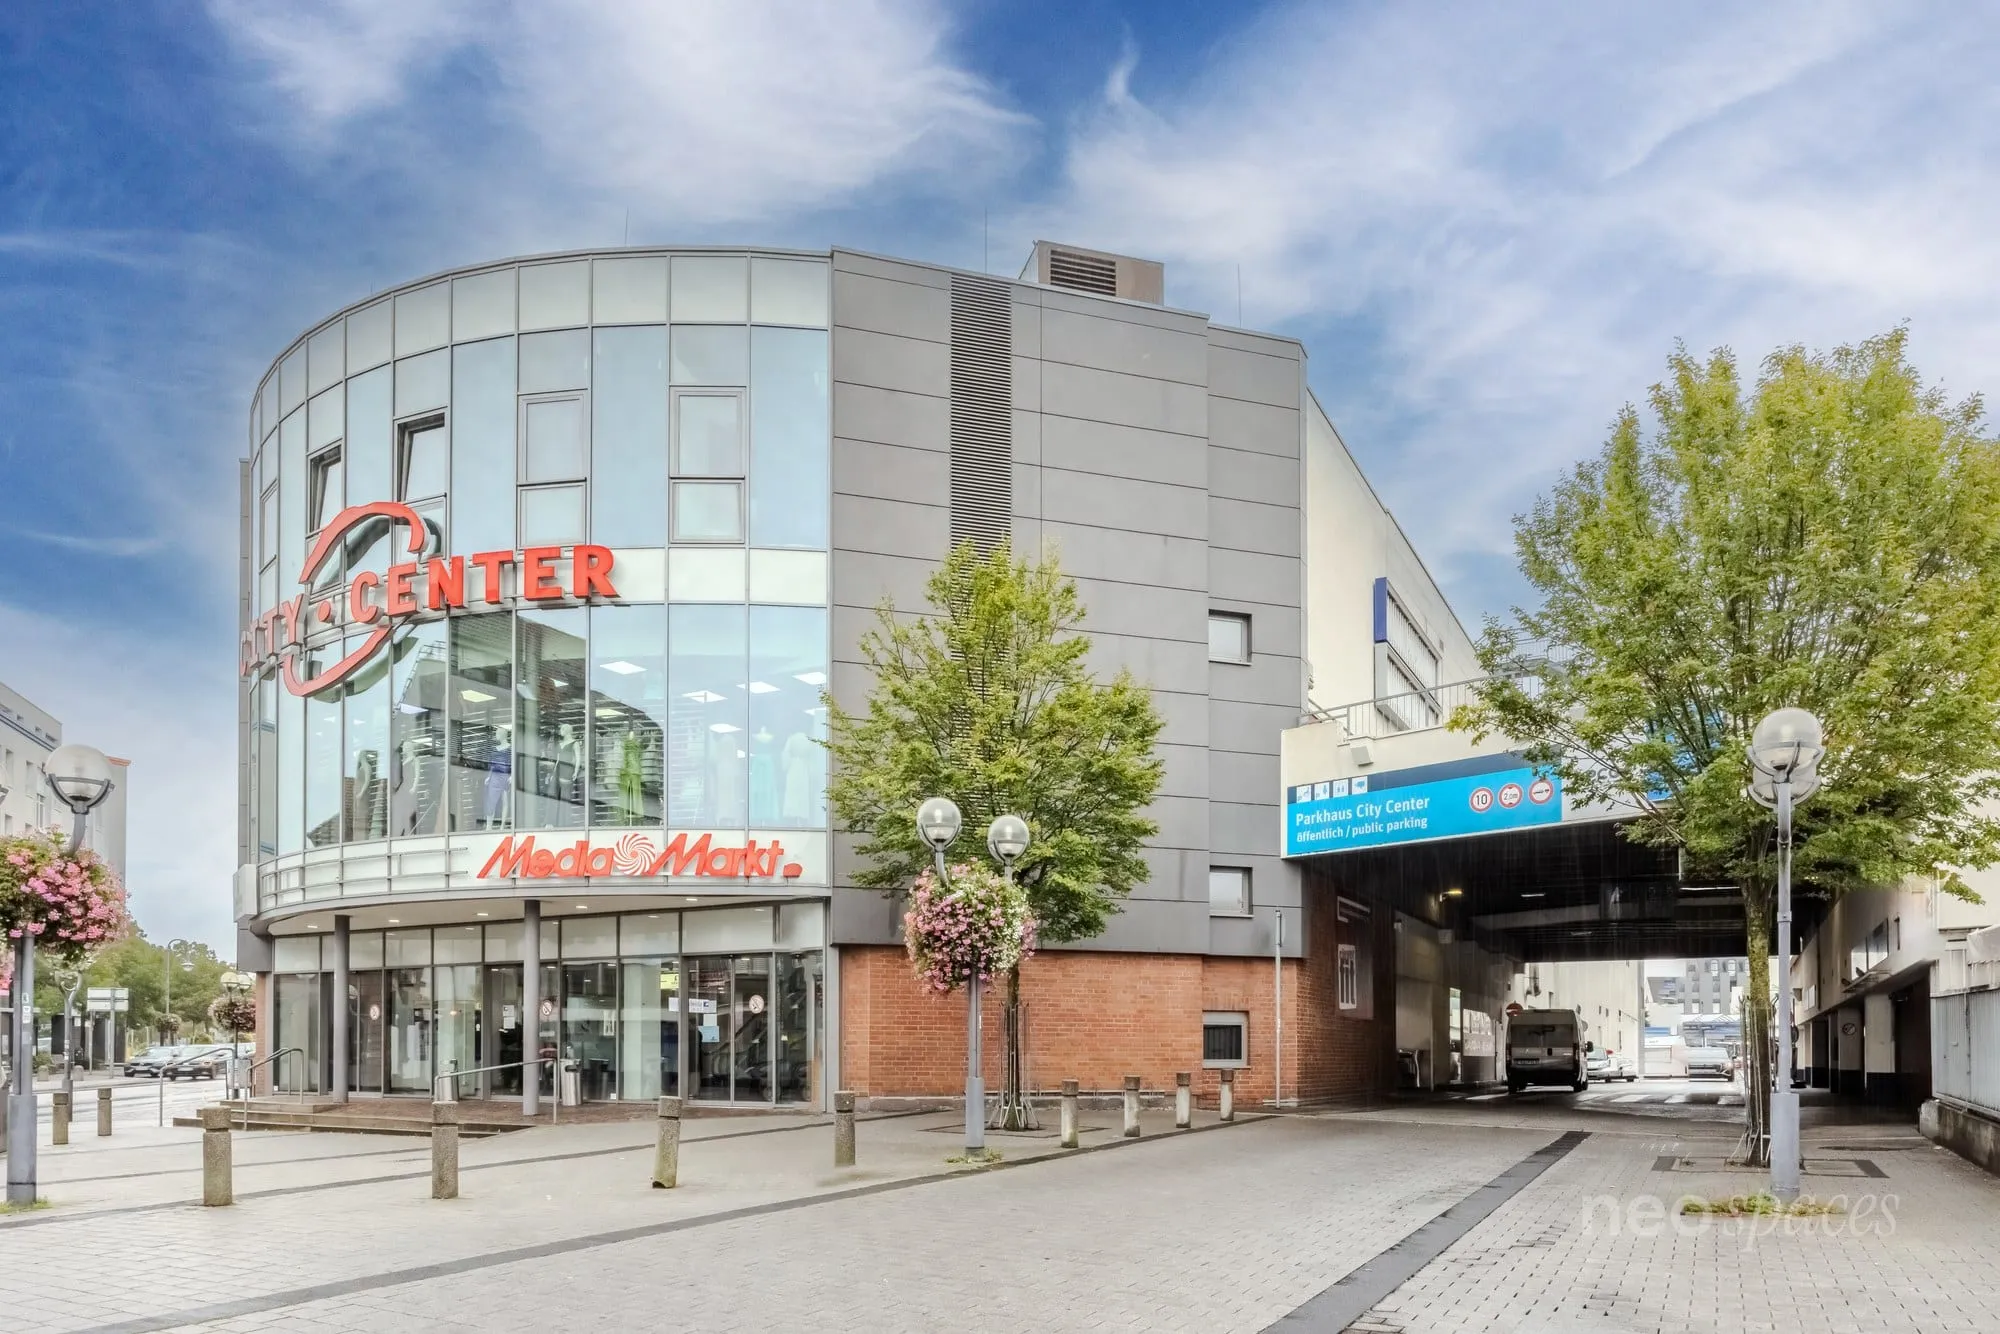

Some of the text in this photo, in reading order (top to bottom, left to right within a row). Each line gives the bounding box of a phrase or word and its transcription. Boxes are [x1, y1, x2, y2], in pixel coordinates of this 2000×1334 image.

[240, 545, 620, 676] CITY CENTER
[1295, 797, 1430, 826] Parkhaus City Center
[1476, 793, 1488, 806] 10
[1352, 822, 1384, 838] public
[1386, 816, 1428, 833] parking
[476, 835, 615, 879] Media
